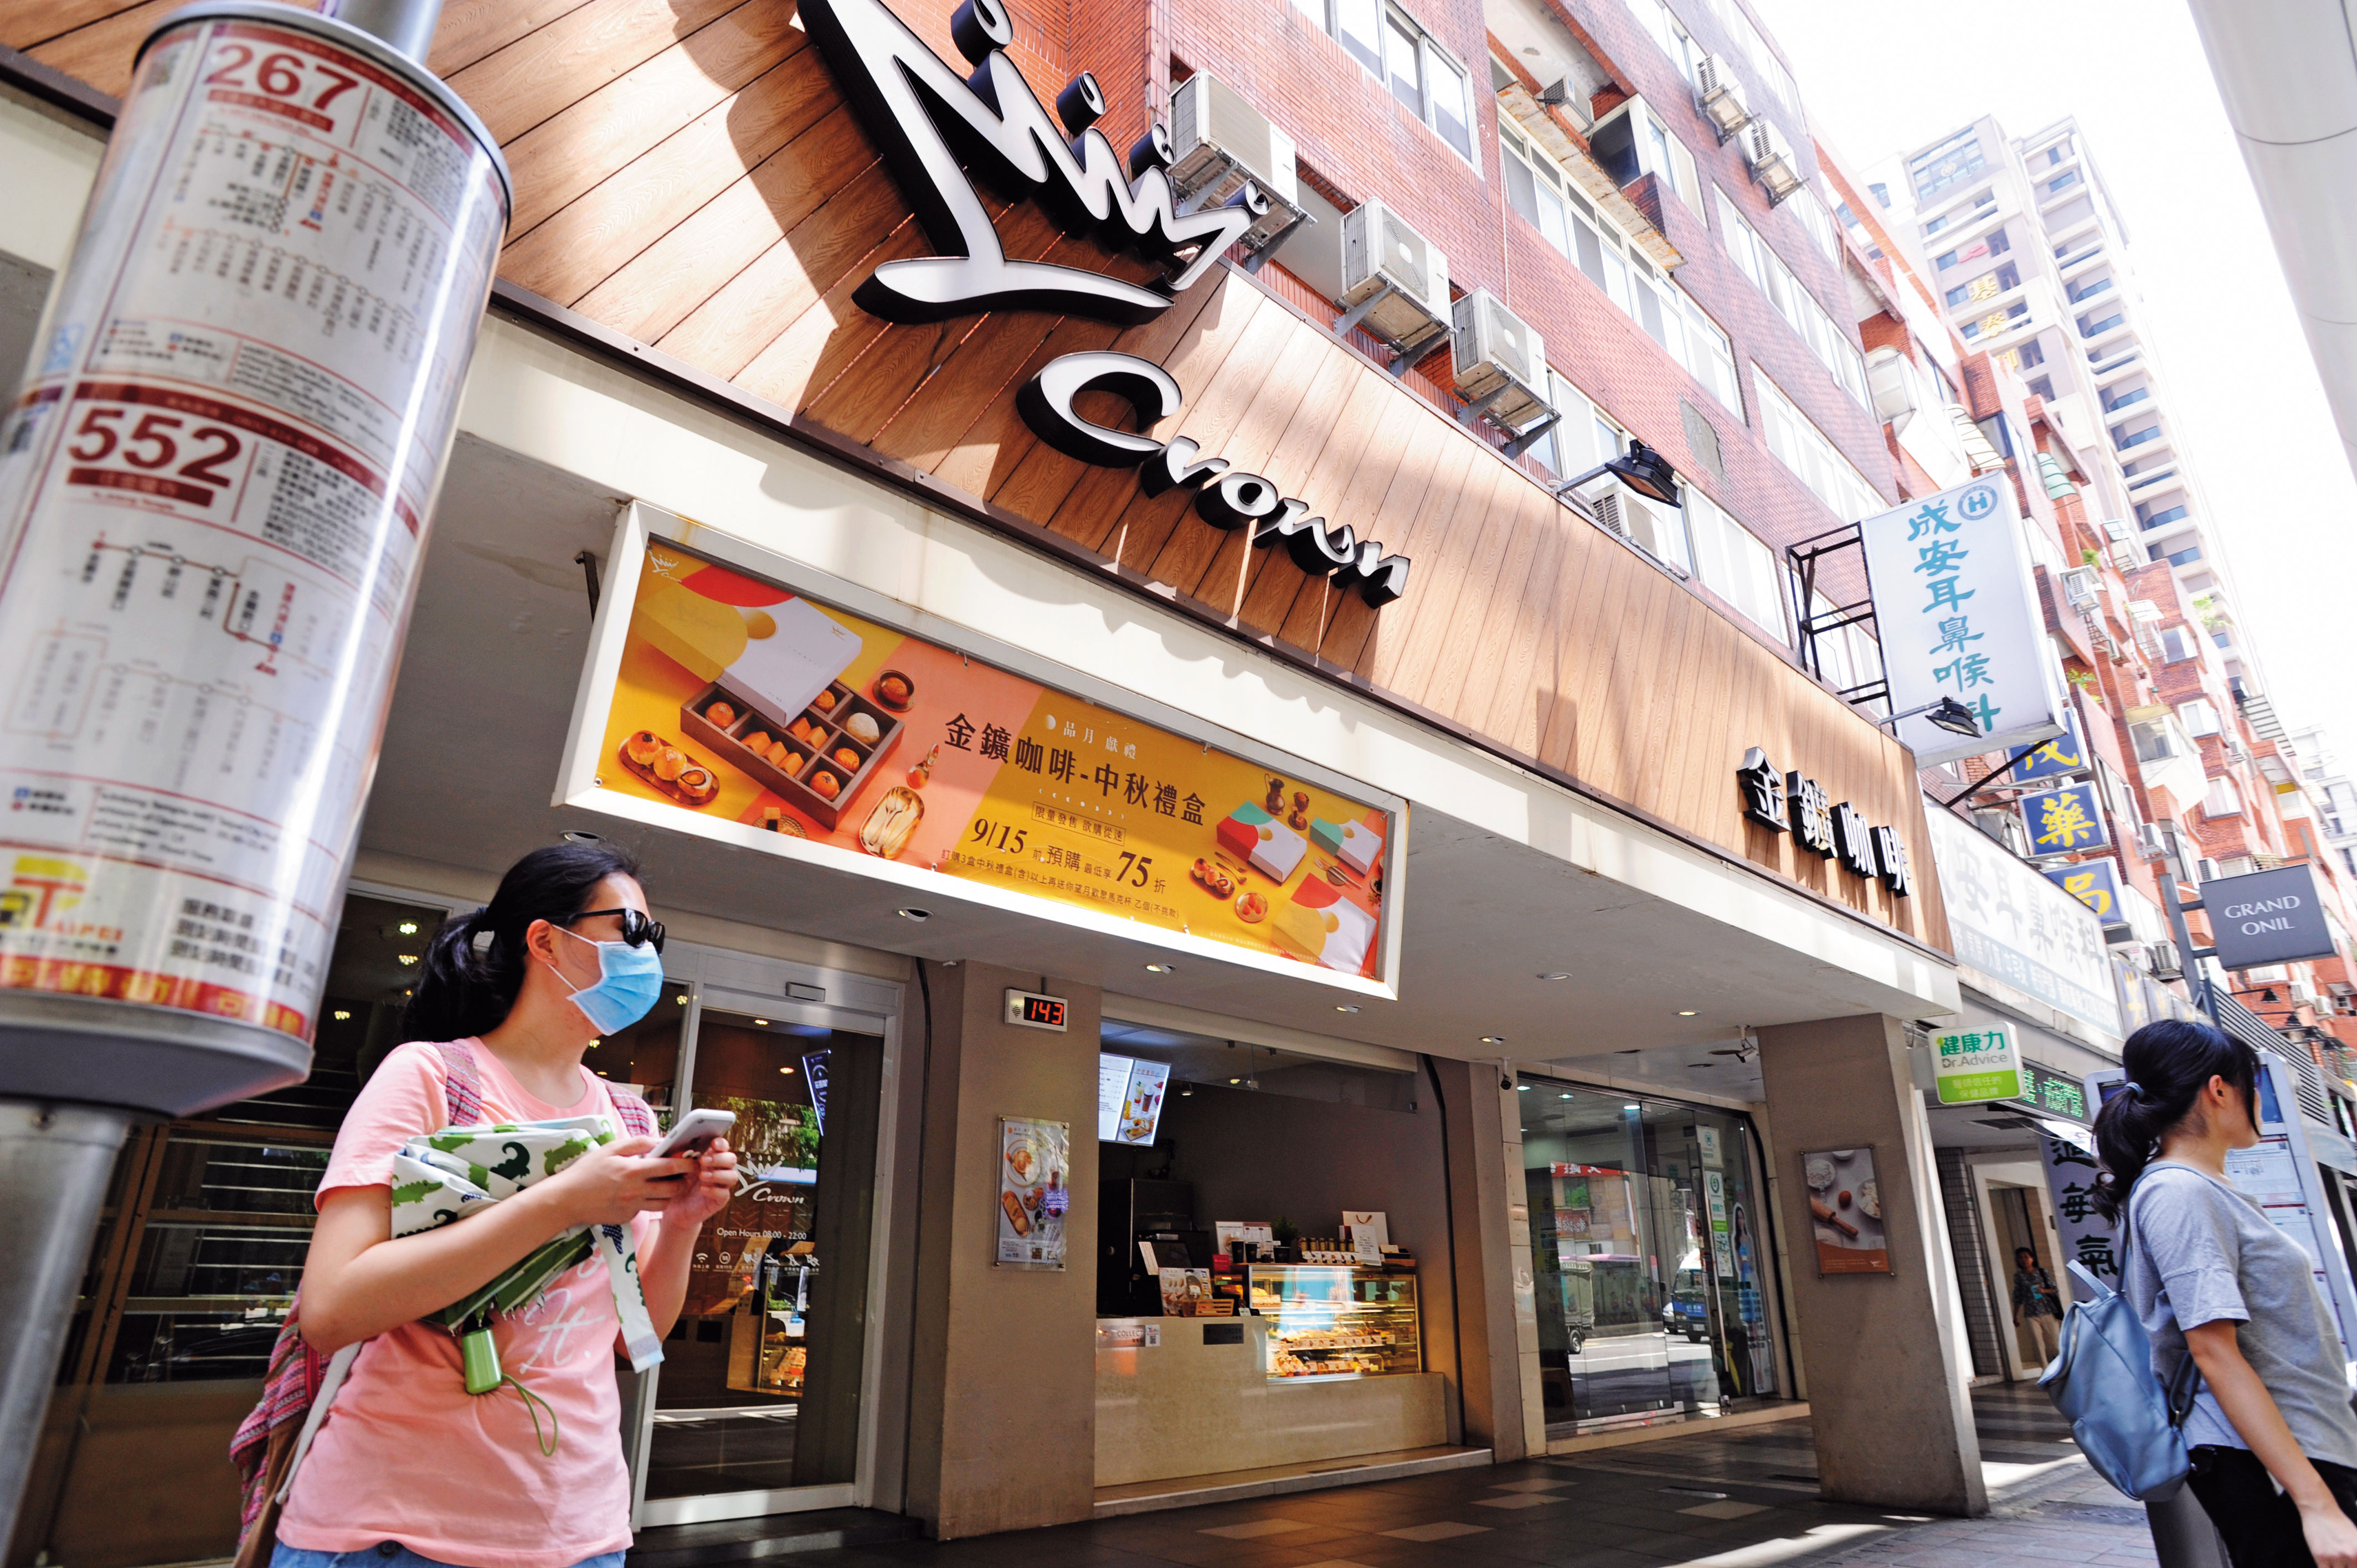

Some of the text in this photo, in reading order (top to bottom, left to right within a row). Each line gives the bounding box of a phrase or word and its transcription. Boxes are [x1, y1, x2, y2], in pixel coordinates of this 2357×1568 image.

[204, 43, 359, 111] 267
[69, 408, 241, 488] 552
[1017, 351, 1411, 608] Crown
[970, 818, 1028, 854] 9/15
[1046, 845, 1082, 872] 預購
[1116, 851, 1152, 888] 75
[1154, 877, 1166, 895] 折
[2225, 895, 2301, 918] GRAND
[2241, 917, 2296, 935] ONIL
[1031, 1000, 1064, 1025] 143
[1938, 1030, 2006, 1056] 健康力
[753, 1187, 805, 1205] Crown
[717, 1227, 737, 1238] Open
[739, 1229, 761, 1239] Hours
[763, 1230, 782, 1239] 08:00
[788, 1231, 807, 1240] 22:00
